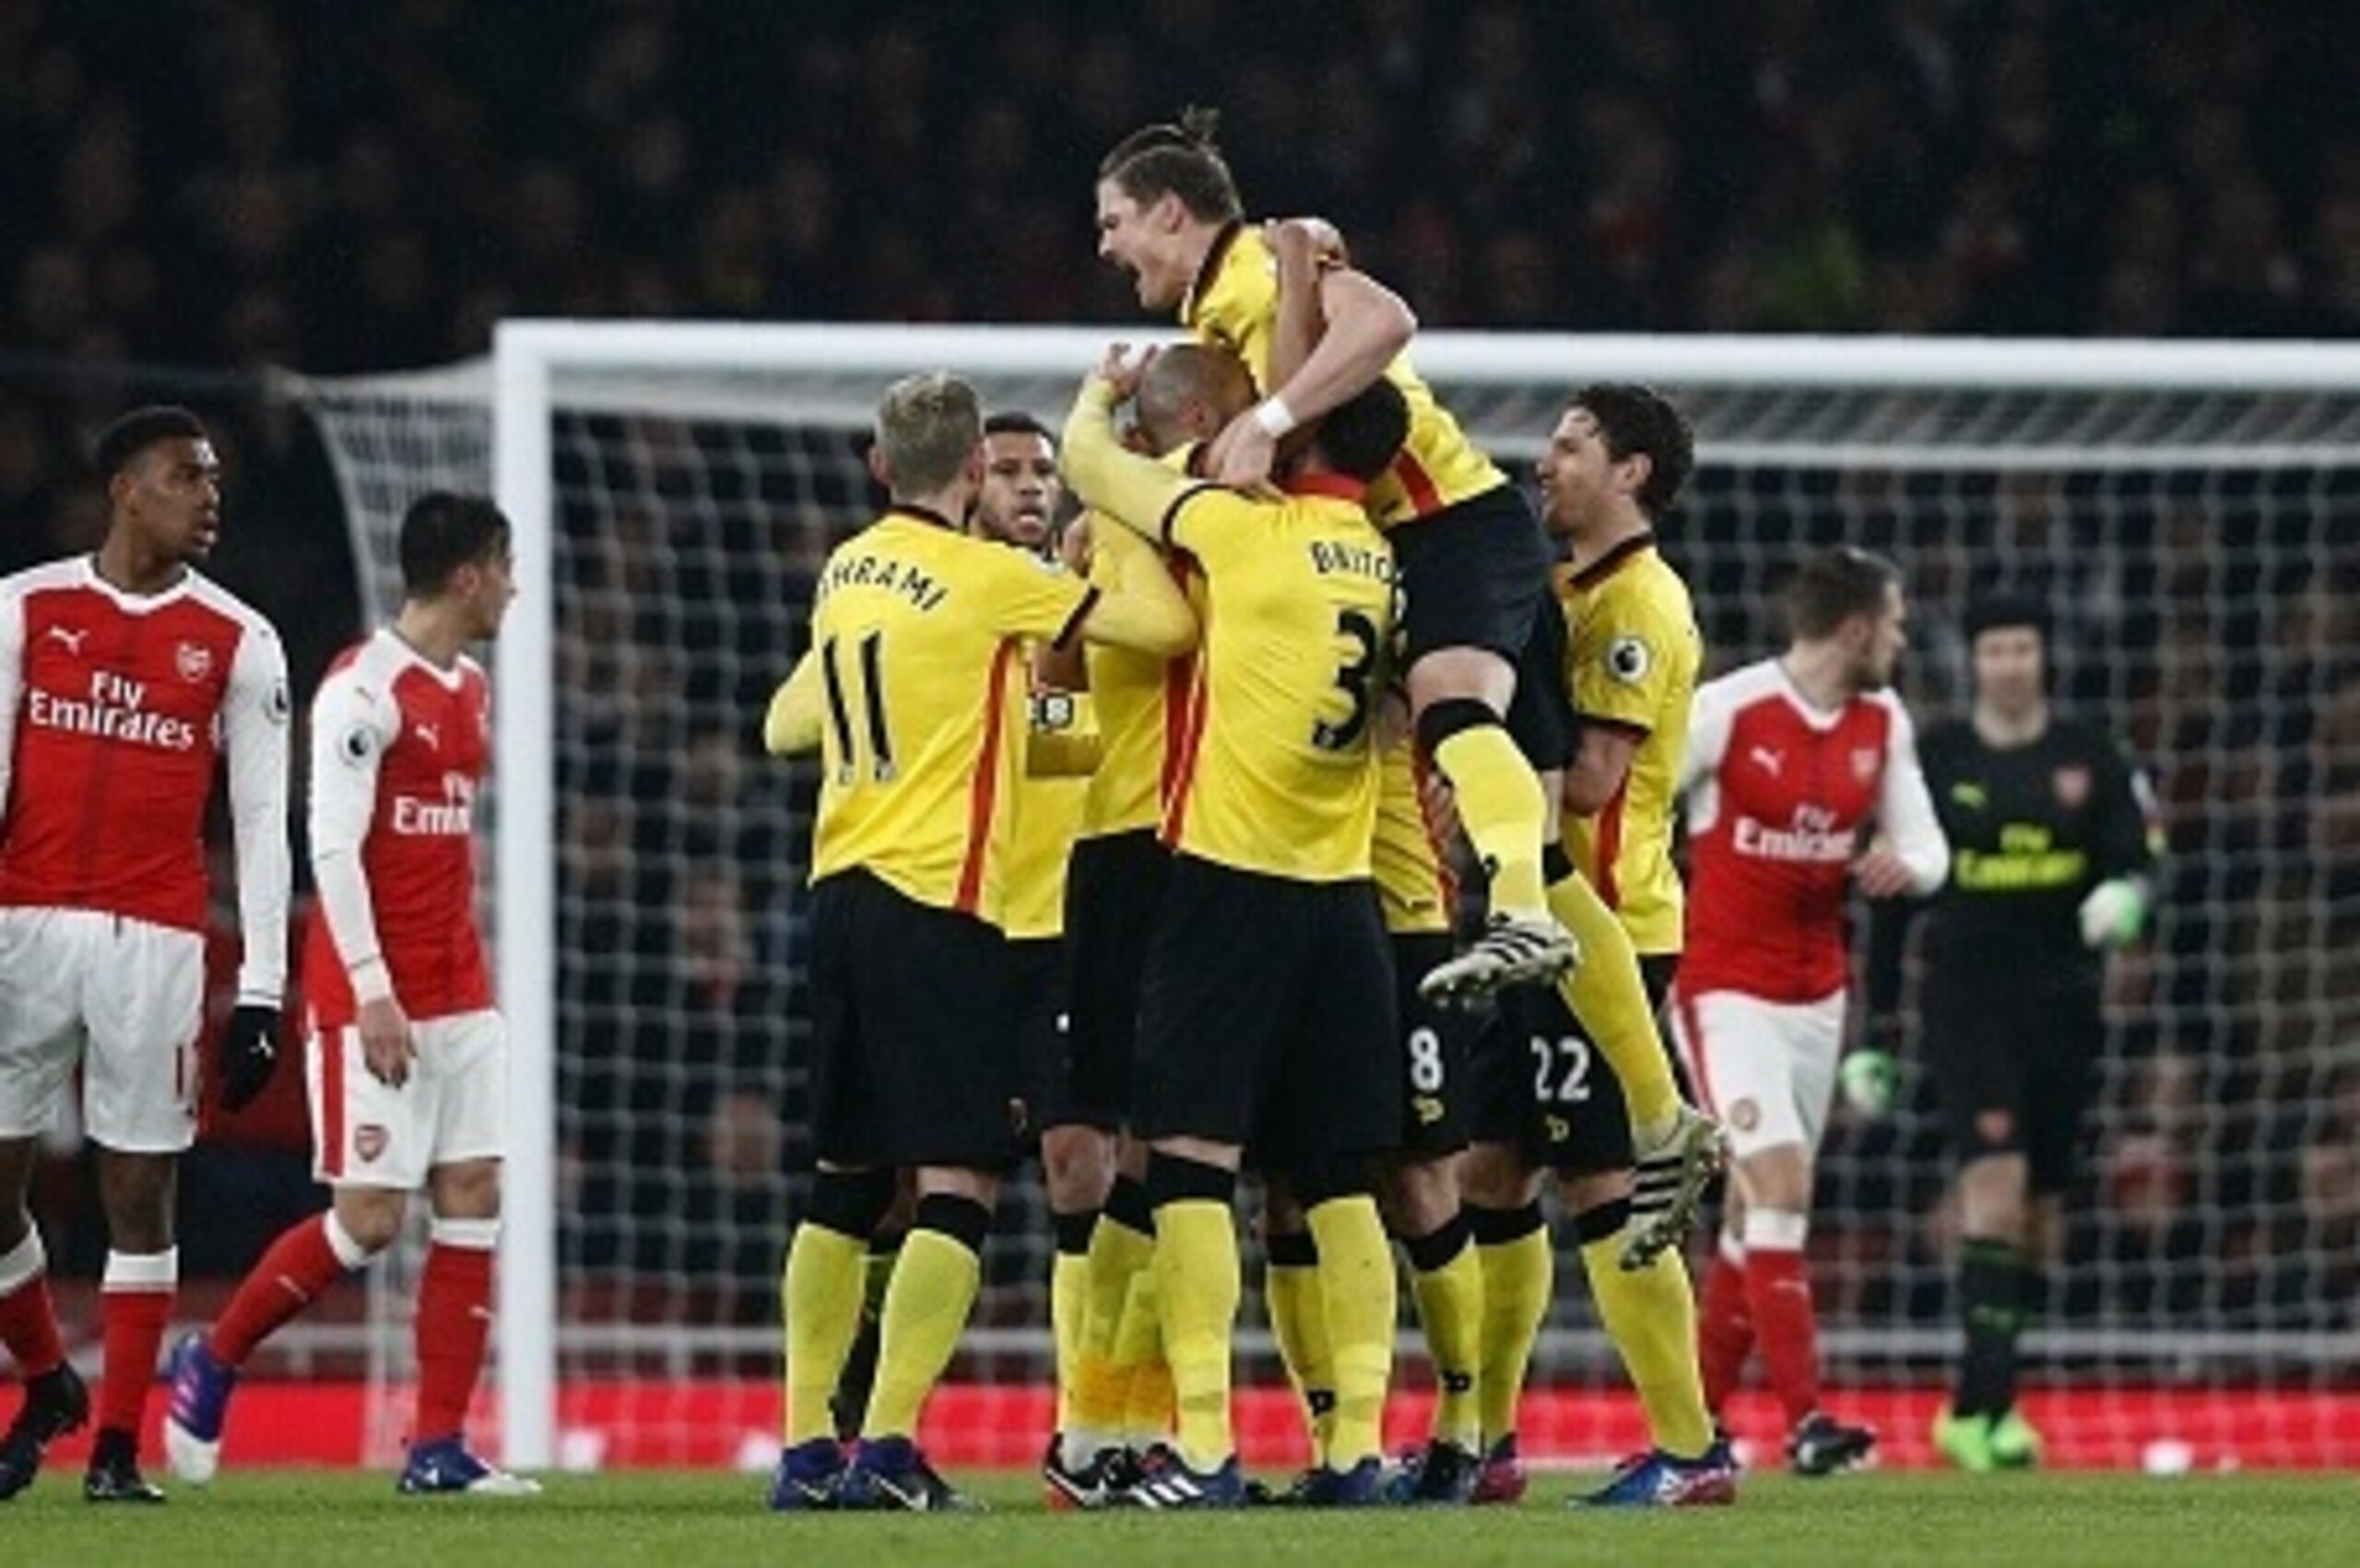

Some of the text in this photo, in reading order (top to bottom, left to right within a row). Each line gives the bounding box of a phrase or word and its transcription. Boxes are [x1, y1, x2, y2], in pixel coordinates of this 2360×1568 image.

[29, 690, 195, 751] Emirates
[91, 670, 146, 711] Fly
[821, 629, 900, 785] 11
[1409, 1026, 1445, 1092] 8
[1529, 1035, 1592, 1101] 22
